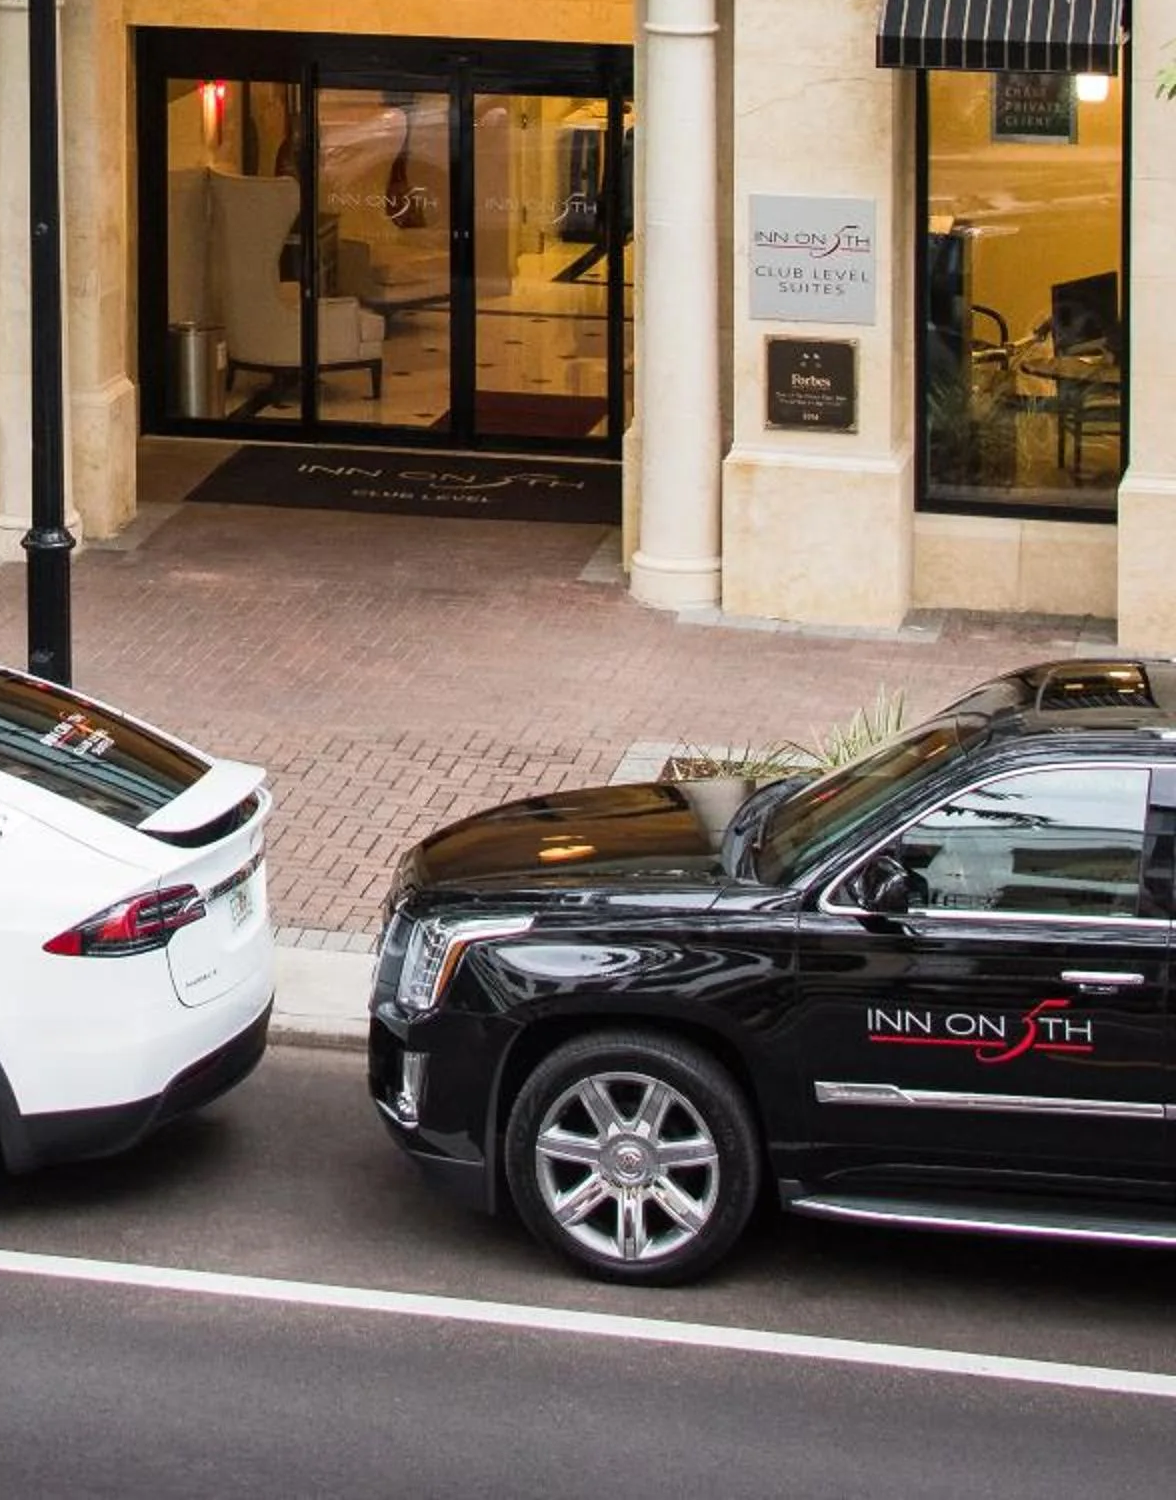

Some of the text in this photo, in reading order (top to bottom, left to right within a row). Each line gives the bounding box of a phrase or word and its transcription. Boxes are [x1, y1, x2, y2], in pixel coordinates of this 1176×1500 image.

[326, 192, 362, 206] INN
[794, 232, 827, 246] ON
[755, 265, 870, 283] CLUB LEVEL
[778, 281, 846, 296] SUITES
[791, 373, 831, 388] Forbes
[297, 463, 382, 478] INN
[397, 470, 477, 484] ON
[867, 1007, 932, 1034] INN
[945, 1012, 1006, 1038] ON
